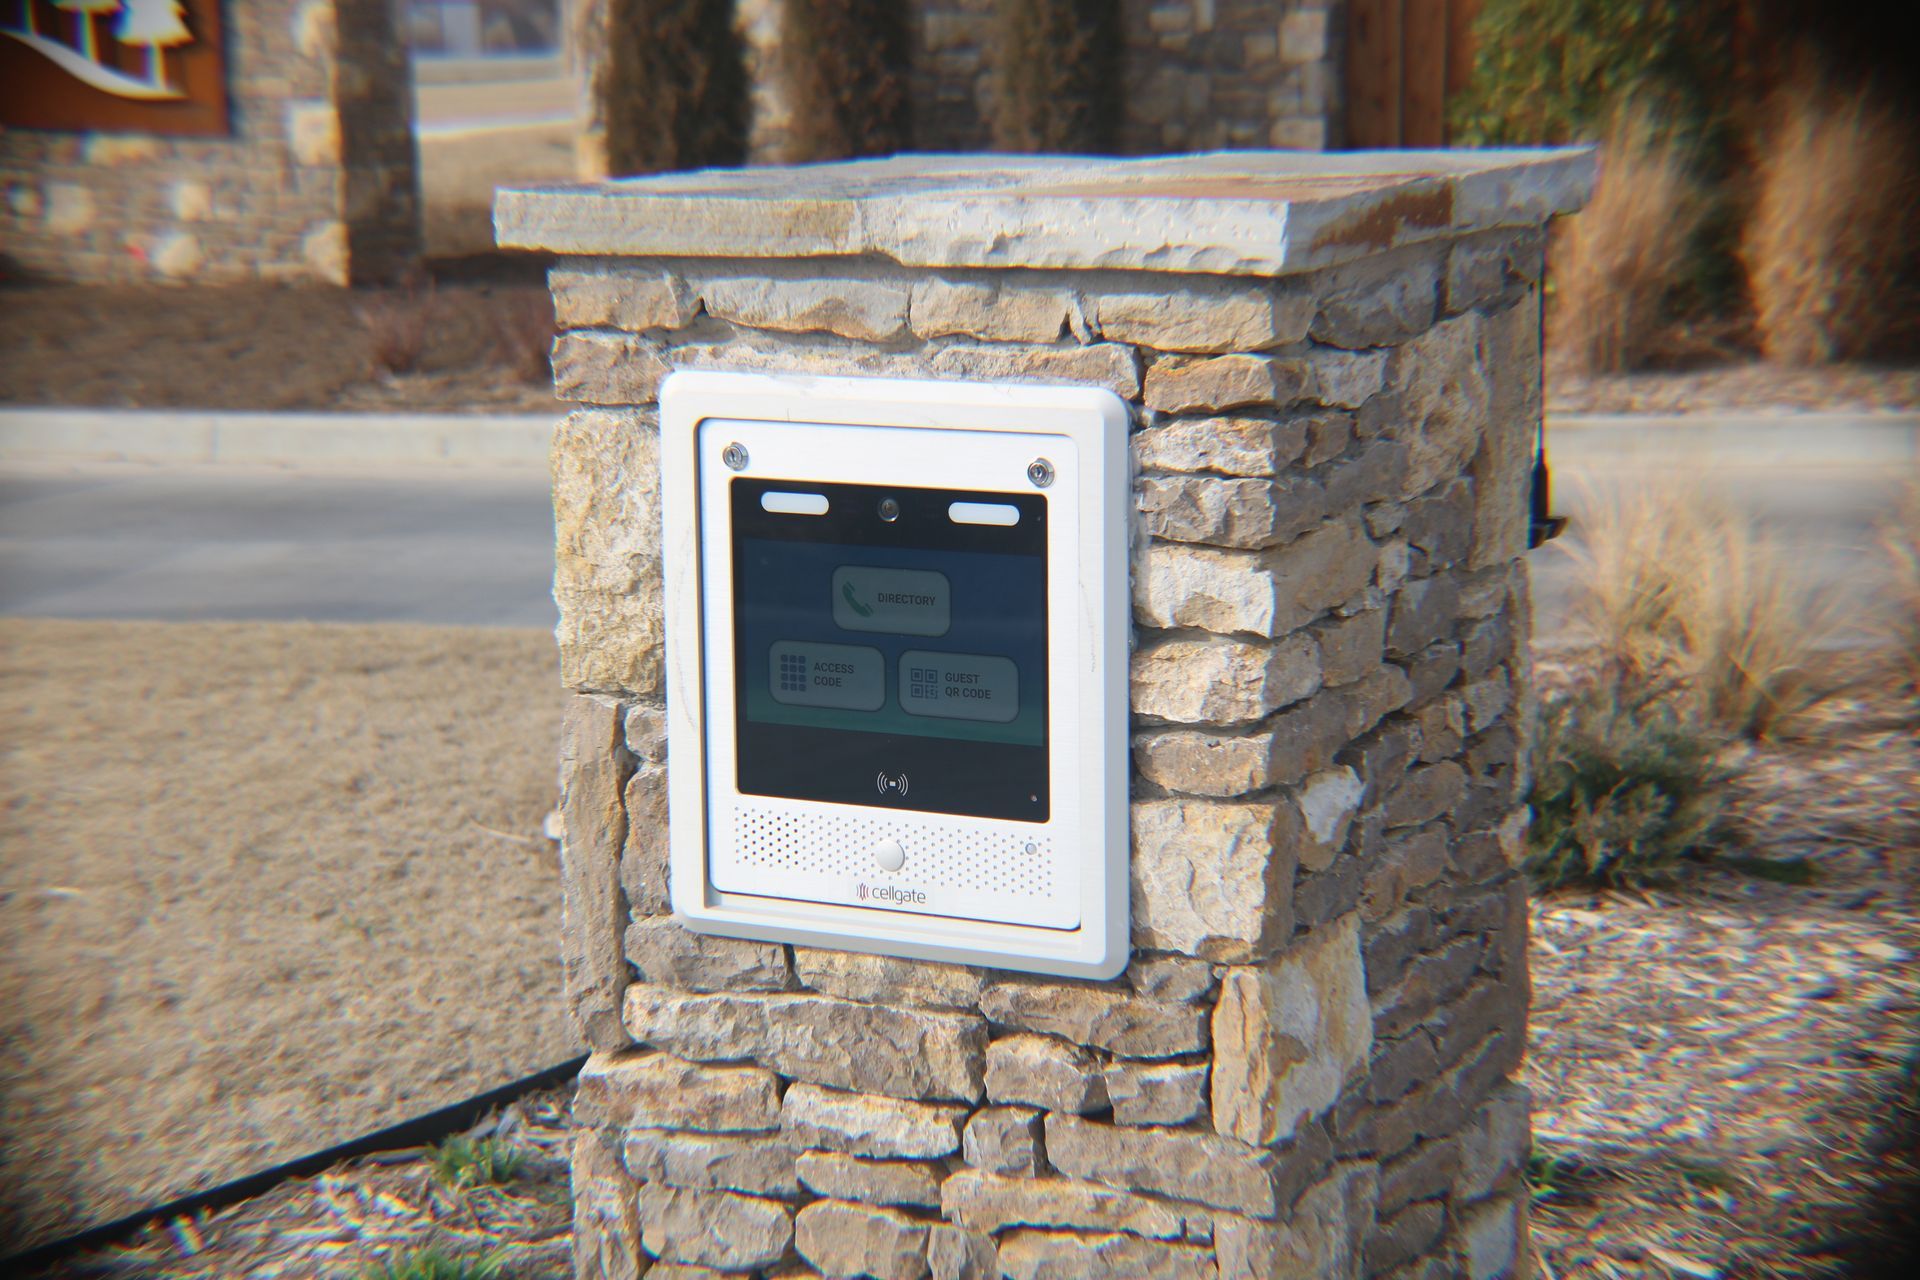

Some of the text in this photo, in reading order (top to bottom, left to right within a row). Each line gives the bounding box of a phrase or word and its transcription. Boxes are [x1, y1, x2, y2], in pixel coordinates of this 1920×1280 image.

[878, 593, 936, 606] DIRECTORY
[814, 662, 854, 674] ACCESS
[814, 676, 842, 687] CODE
[945, 672, 980, 684] GUEST
[945, 686, 992, 700] QR CODE
[872, 886, 926, 905] cellgate
